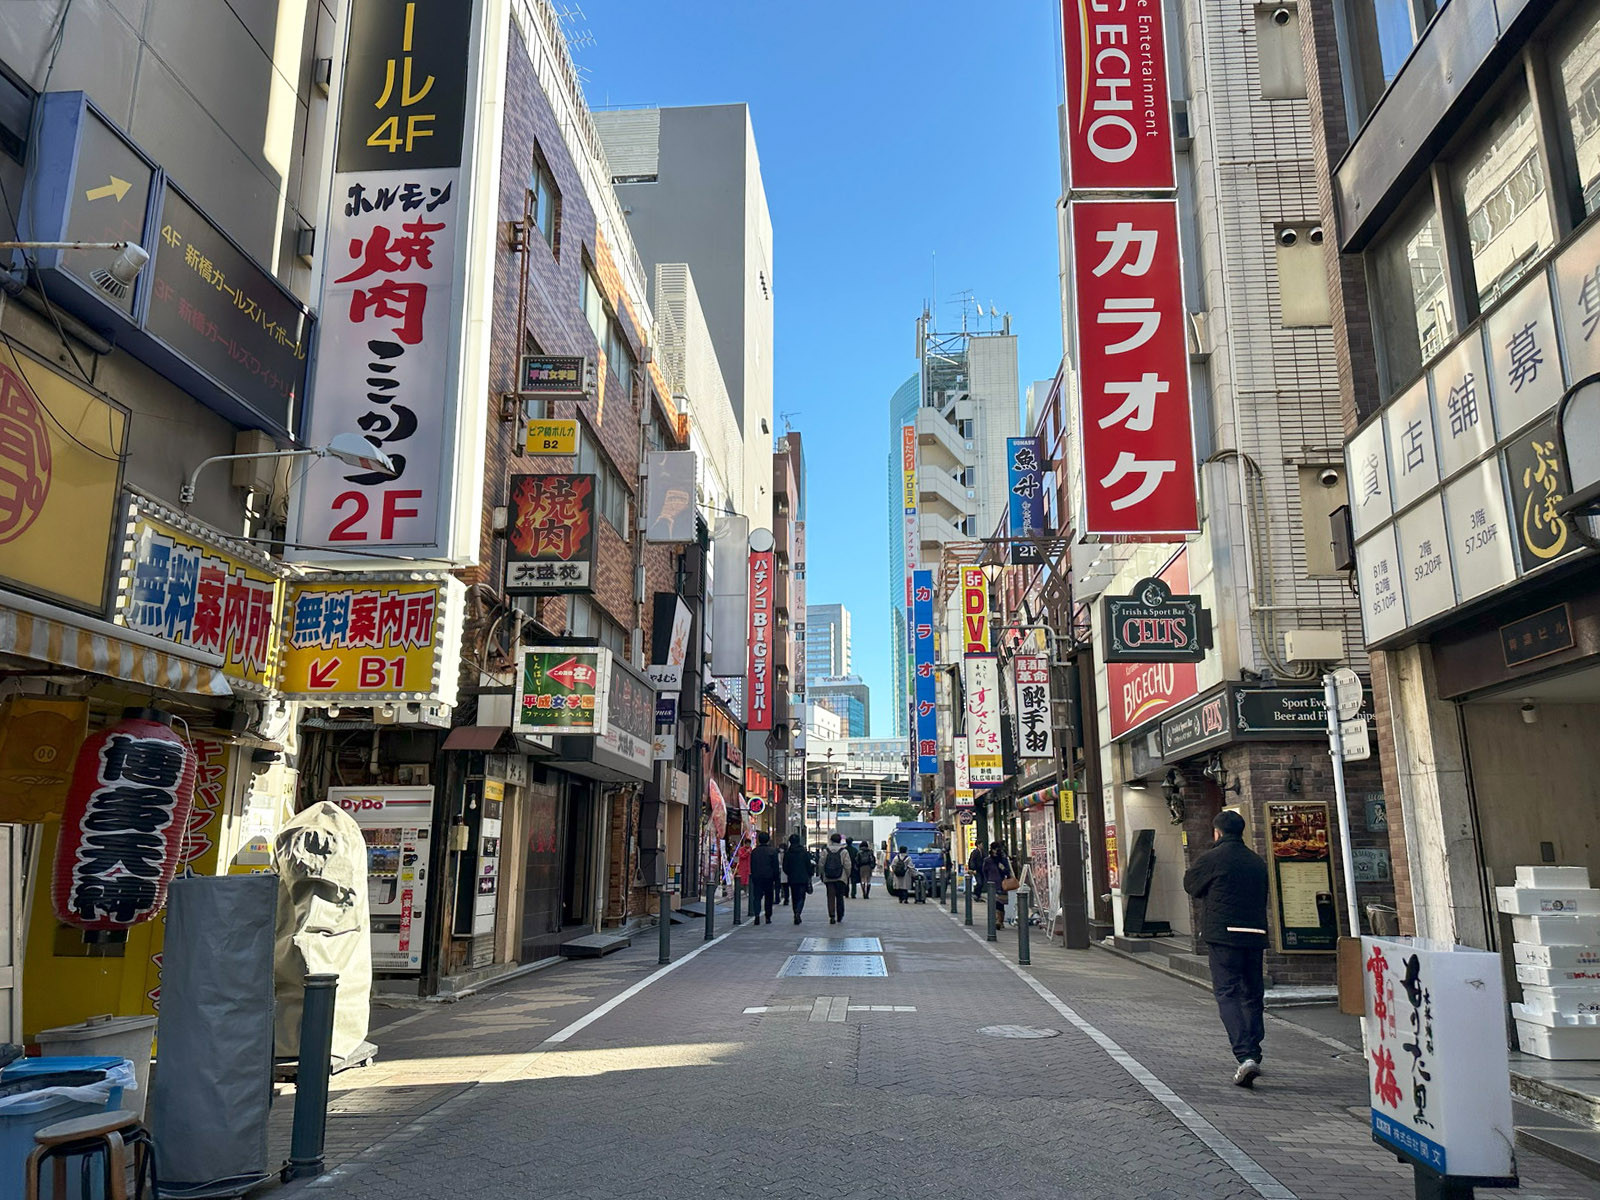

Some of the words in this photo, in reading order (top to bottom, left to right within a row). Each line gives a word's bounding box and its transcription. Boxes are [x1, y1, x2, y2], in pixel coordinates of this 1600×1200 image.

[1138, 15, 1158, 137] Entertainment
[366, 114, 436, 152] 4F
[344, 180, 452, 217] ホルモン
[161, 225, 182, 249] 4F
[334, 214, 447, 345] 焼肉
[1092, 222, 1177, 511] カラオケ
[543, 440, 559, 449] B2
[328, 489, 423, 542] 2F
[528, 478, 577, 560] 焼肉
[1470, 509, 1487, 529] 3階
[1419, 540, 1433, 559] 2階
[1464, 522, 1498, 556] 57.50坪
[966, 575, 982, 586] 5F
[1373, 560, 1388, 579] B1階
[1414, 555, 1442, 581] 59.20坪
[1375, 577, 1391, 596] B2階
[128, 536, 275, 673] 無料案内所
[1122, 608, 1142, 616] Irish
[1143, 608, 1149, 616] &
[1149, 608, 1171, 618] Sport
[1172, 608, 1185, 616] Bar
[1373, 592, 1397, 616] 95.10坪
[293, 593, 435, 645] 無料案内所
[1122, 617, 1188, 648] CELTS
[359, 656, 406, 689] B1
[915, 586, 937, 756] カラオケ館
[1017, 659, 1047, 670] 居酒屋
[1017, 670, 1047, 682] 革命
[822, 675, 851, 683] Yakult
[523, 693, 596, 710] 平成女学園
[1123, 676, 1143, 722] BIG
[1142, 663, 1175, 696] ECHO
[1282, 698, 1309, 712] Sport
[1202, 698, 1223, 736] CELTS
[1274, 711, 1296, 721] Beer
[1297, 711, 1316, 721] and
[340, 798, 383, 813] DyDo
[70, 734, 187, 923] 博多天神
